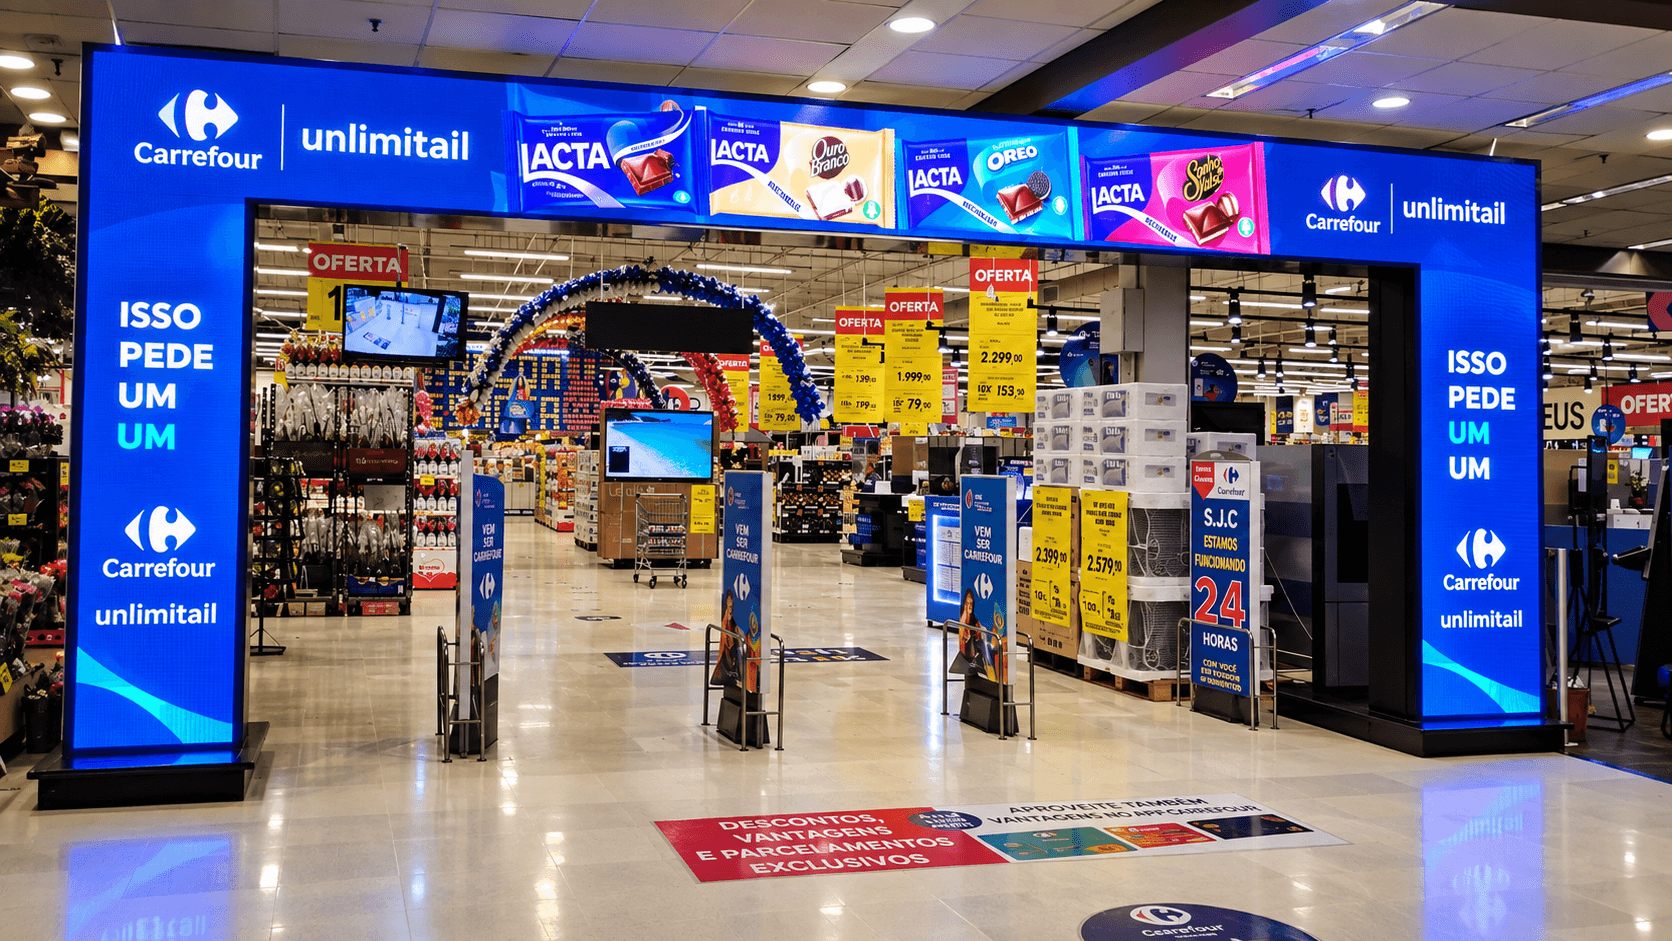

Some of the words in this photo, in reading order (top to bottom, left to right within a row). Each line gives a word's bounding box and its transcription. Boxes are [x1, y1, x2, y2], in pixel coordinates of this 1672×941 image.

[133, 142, 262, 170] Carrefour
[301, 123, 469, 160] unlimitail
[711, 138, 769, 165] LACTA
[812, 138, 845, 160] Ouro
[521, 142, 611, 183] LACTA
[810, 153, 850, 177] Branco
[987, 145, 1038, 171] OREO
[908, 167, 962, 197] LACTA
[1091, 183, 1146, 214] LACTA
[1306, 213, 1381, 233] Carrefour
[1403, 197, 1505, 224] unlimitail
[313, 253, 402, 274] OFERTA
[975, 269, 1032, 282] OFERTA
[120, 302, 201, 330] ISSO
[890, 302, 939, 312] OFERTA
[839, 318, 882, 328] OFERTA
[120, 342, 214, 370] PEDE
[981, 352, 1022, 366] 2.299,00
[1448, 350, 1506, 375] ISSO
[898, 372, 931, 384] 1.999,00
[118, 382, 176, 409] UM
[908, 398, 932, 412] 79,00
[1448, 386, 1516, 410] PEDE
[1621, 394, 1672, 414] OFER
[117, 423, 175, 450] UM
[1449, 421, 1490, 444] UM
[1449, 456, 1490, 480] UM
[1204, 508, 1238, 528] S.J.C
[735, 523, 749, 536] VEM
[974, 526, 992, 538] VEM
[736, 537, 748, 549] SER
[976, 538, 990, 550] SER
[1204, 534, 1238, 551] ESTAMOS
[1036, 546, 1068, 568] 2.399,00
[1194, 553, 1246, 572] FUNCIONANDO
[102, 558, 216, 578] Carrefour
[1443, 574, 1520, 591] Carrefour
[1194, 576, 1246, 628] 24
[96, 603, 217, 626] unlimitail
[1440, 610, 1522, 628] unlimitail
[1203, 632, 1238, 652] HORAS
[987, 812, 1103, 824] VANTAGENS
[1166, 805, 1262, 816] CARREFOUR
[1009, 802, 1122, 814] APROVEITE
[1121, 798, 1209, 809] TAMBÉM
[718, 814, 885, 830] DESCONTOS,
[733, 826, 893, 844] VANTAGENS
[696, 850, 718, 861] E
[723, 837, 954, 860] PARCELAMENTOS
[750, 854, 930, 874] EXCLUSIVOS
